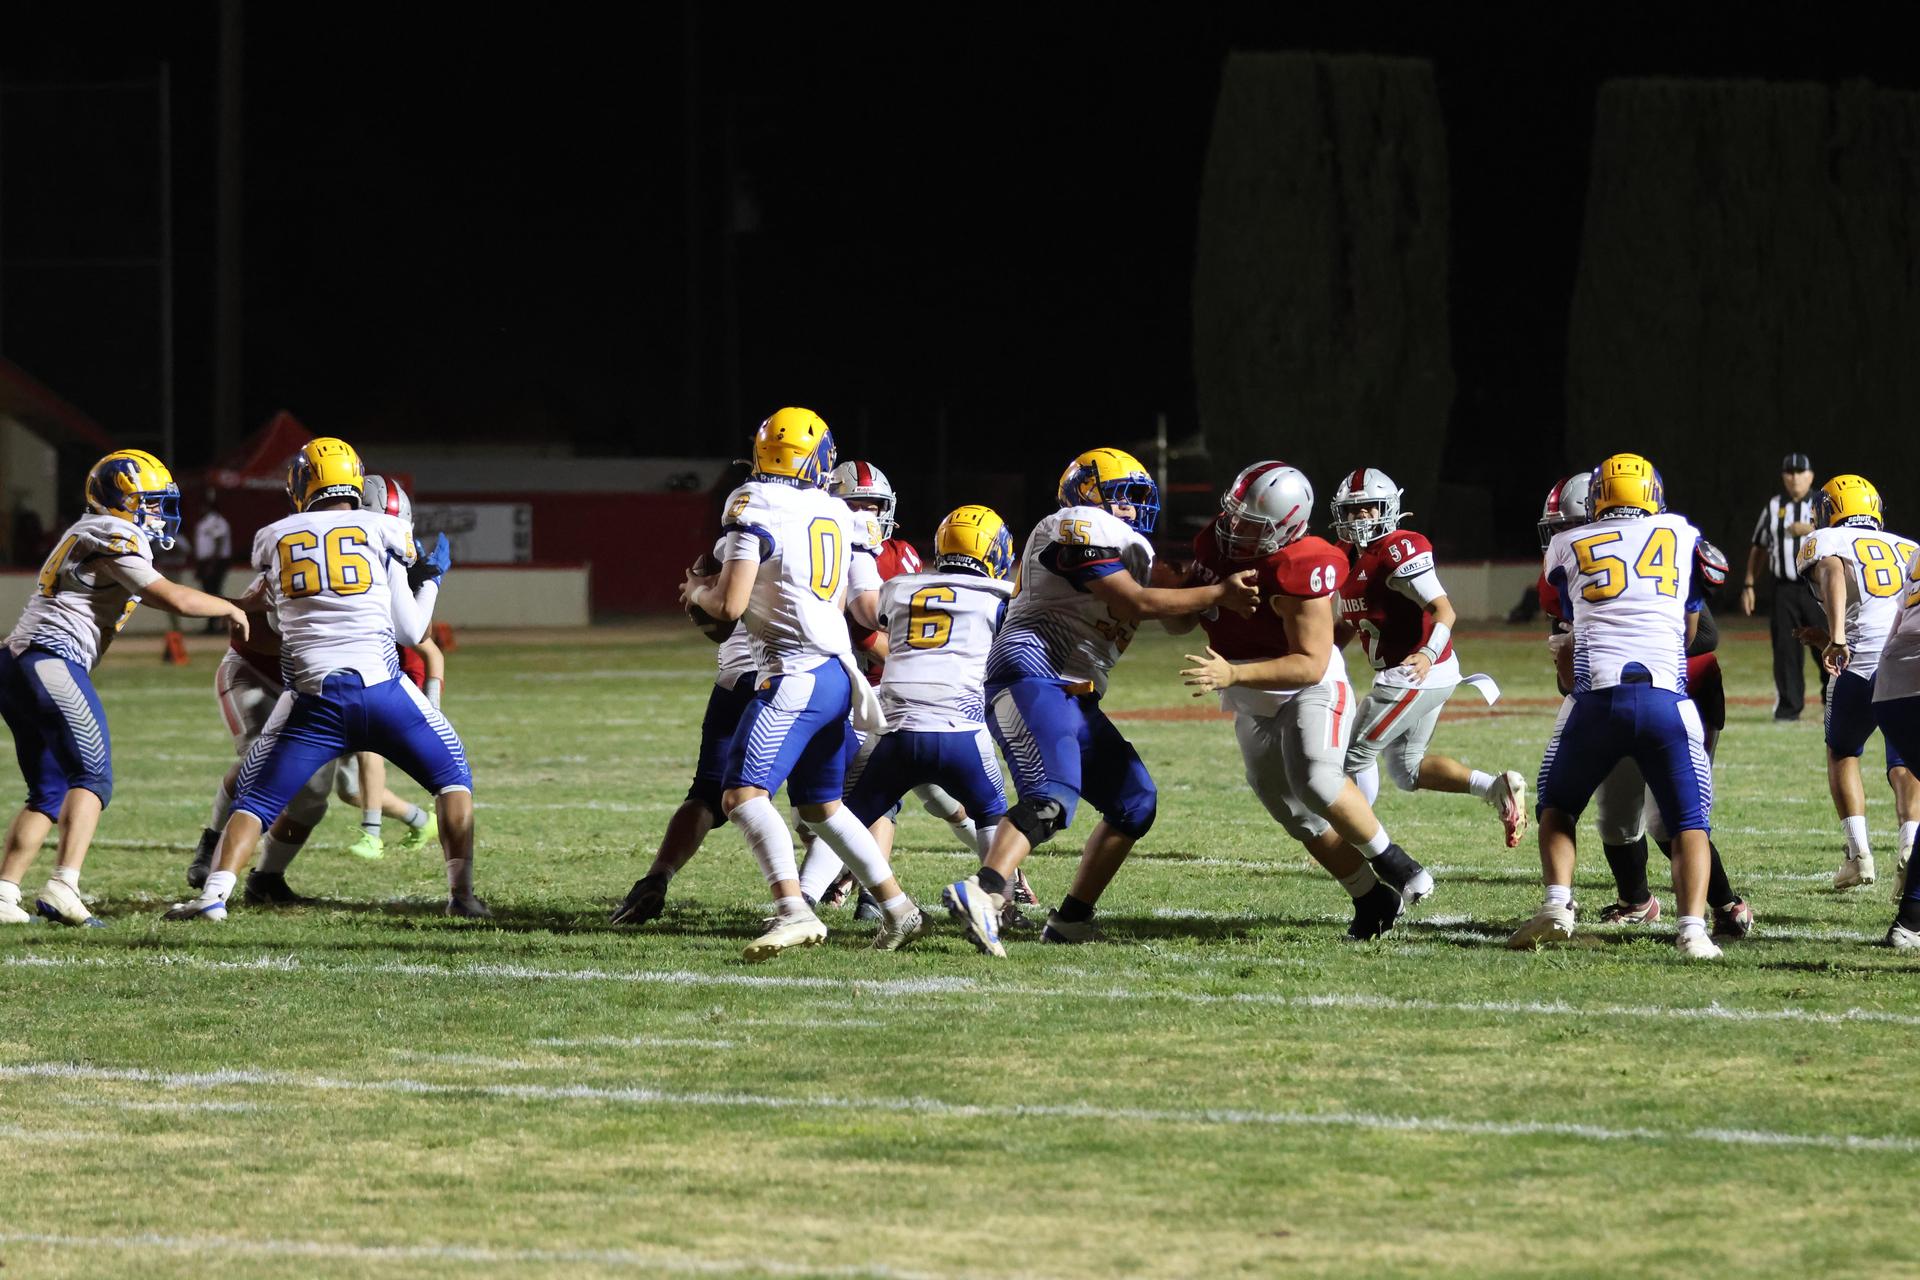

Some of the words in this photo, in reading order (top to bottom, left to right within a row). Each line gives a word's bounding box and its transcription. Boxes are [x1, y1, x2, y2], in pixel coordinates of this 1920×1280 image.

[760, 474, 800, 486] Riddell
[1060, 519, 1093, 546] 55
[1388, 539, 1416, 562] 52
[277, 525, 374, 599] 66
[808, 516, 843, 602] 0
[1310, 564, 1336, 593] 60
[1571, 527, 1680, 603] 54
[905, 586, 957, 650] 6
